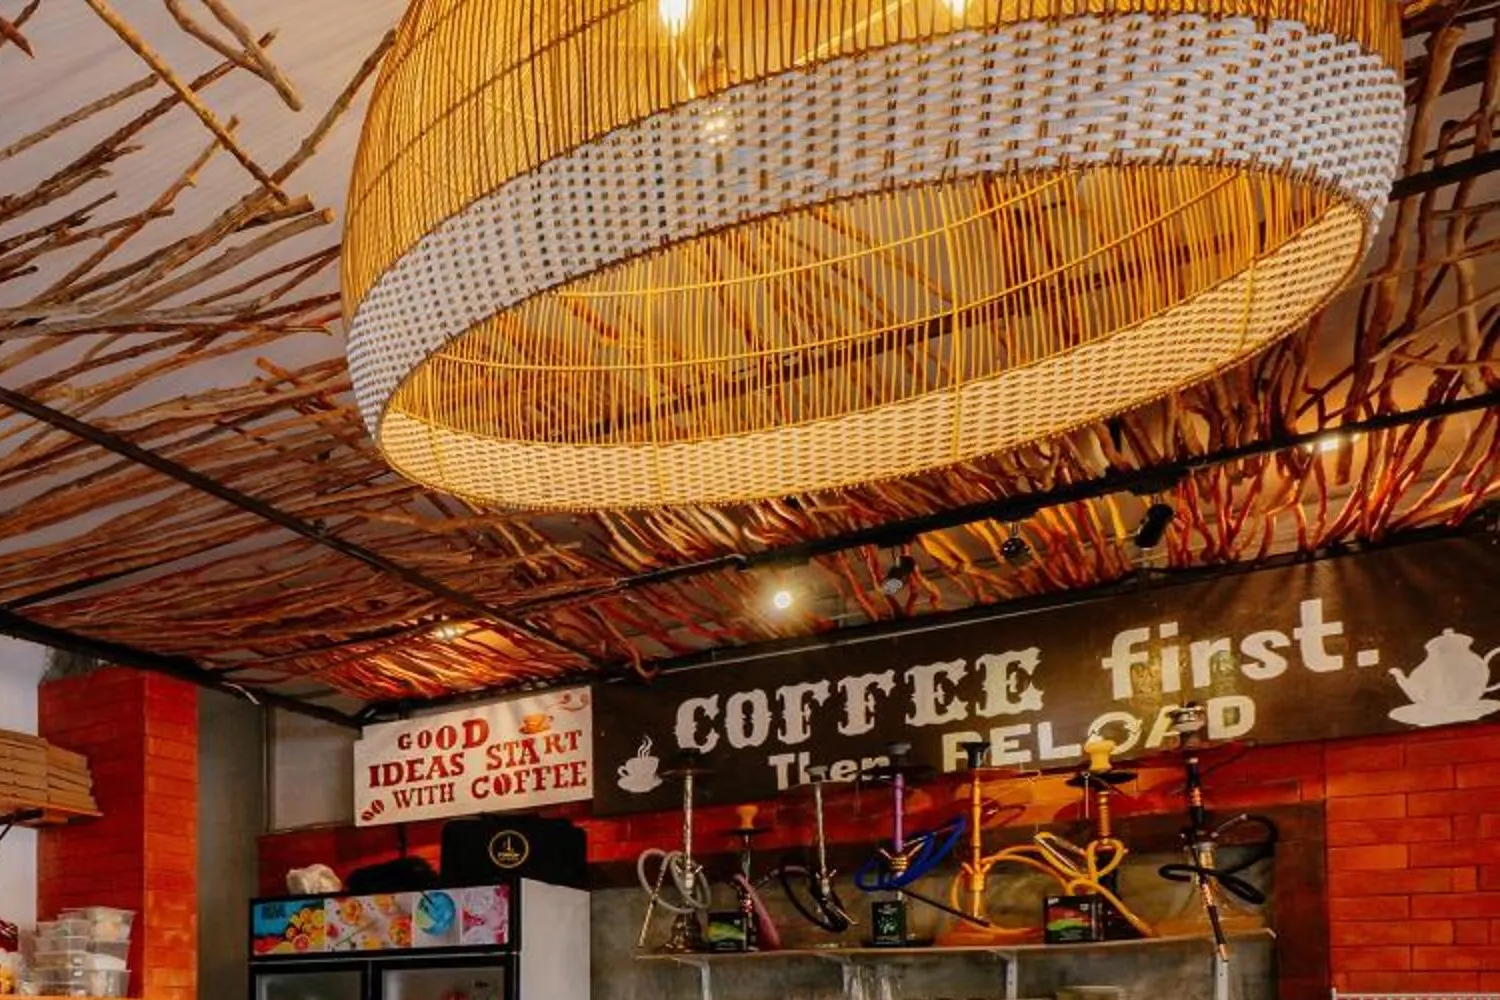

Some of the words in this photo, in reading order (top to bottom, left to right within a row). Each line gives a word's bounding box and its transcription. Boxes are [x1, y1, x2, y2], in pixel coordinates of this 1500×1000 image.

[674, 646, 1045, 754] COFFEE
[1102, 597, 1380, 700] first.
[368, 752, 465, 788] IDEAS
[485, 729, 582, 771] START
[397, 718, 490, 750] GOOD
[392, 782, 456, 808] WITH
[471, 761, 588, 800] COFFEE
